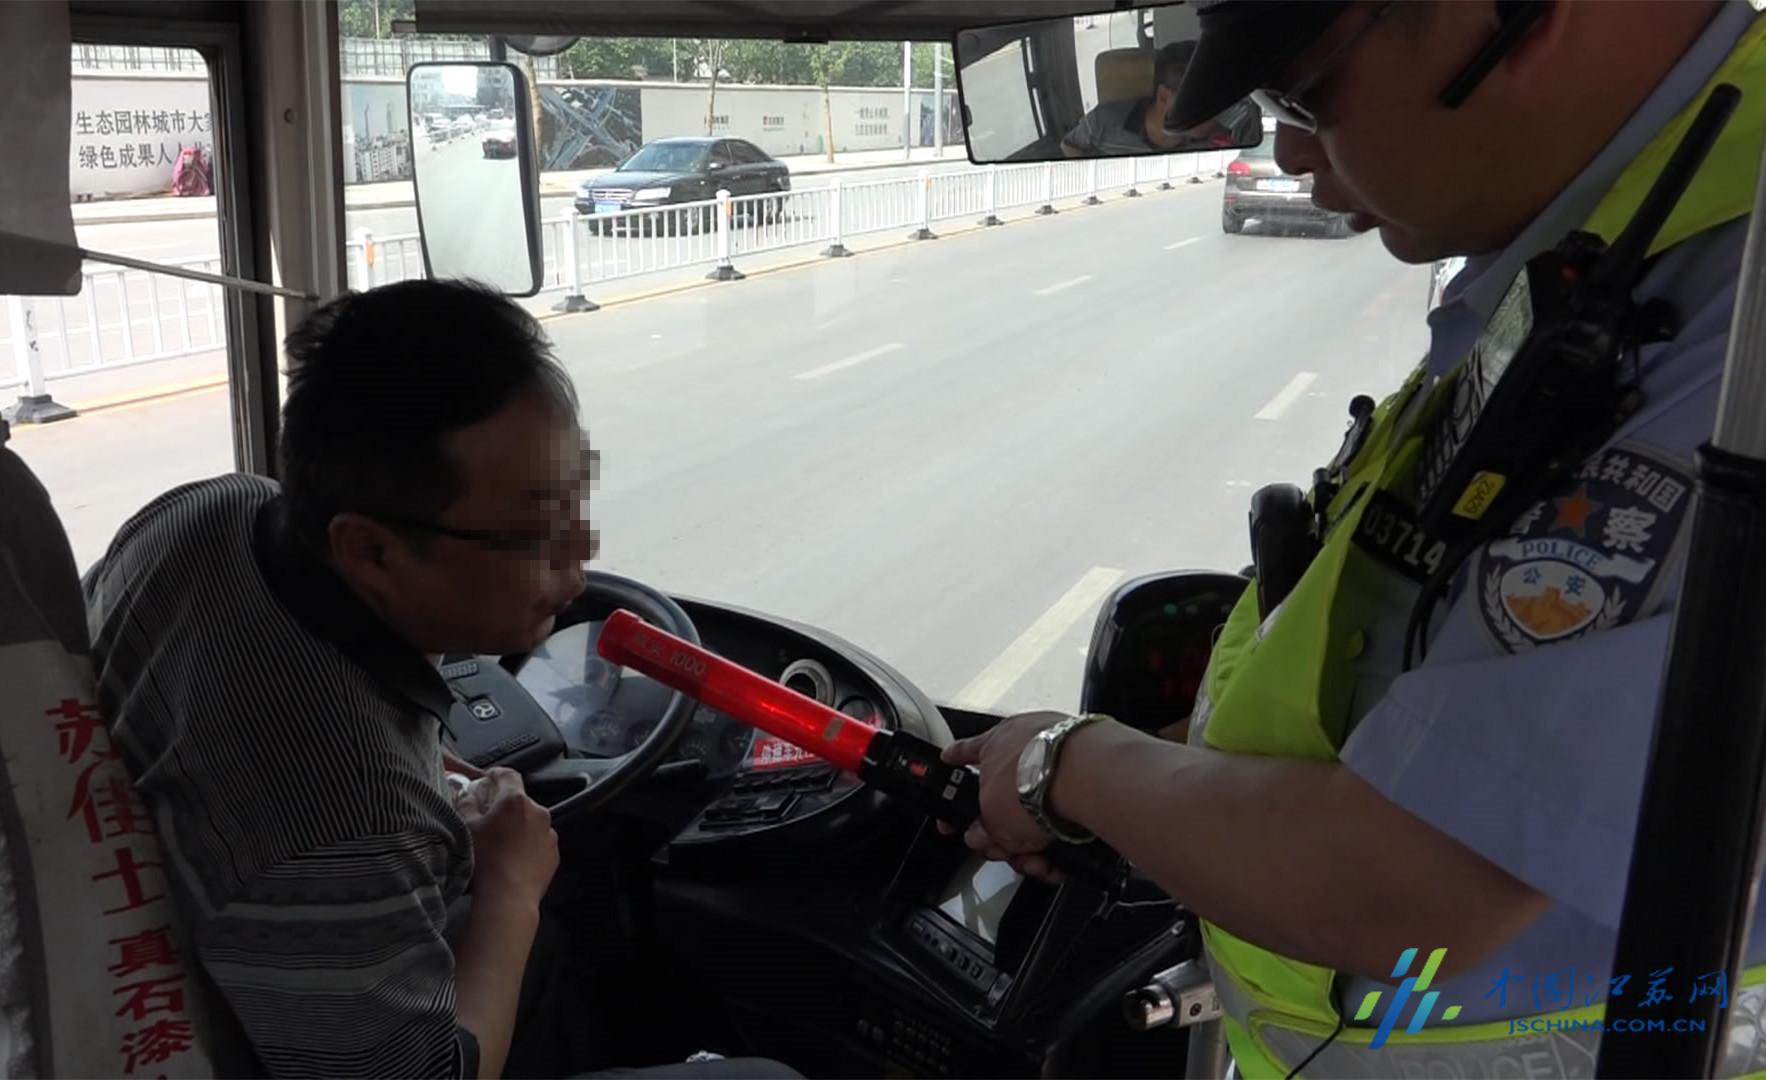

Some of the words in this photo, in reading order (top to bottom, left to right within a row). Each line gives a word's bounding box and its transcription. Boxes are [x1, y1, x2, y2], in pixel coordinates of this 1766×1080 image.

[1362, 503, 1447, 575] 03714
[1521, 538, 1604, 572] POLICE
[1522, 566, 1587, 597] 公安
